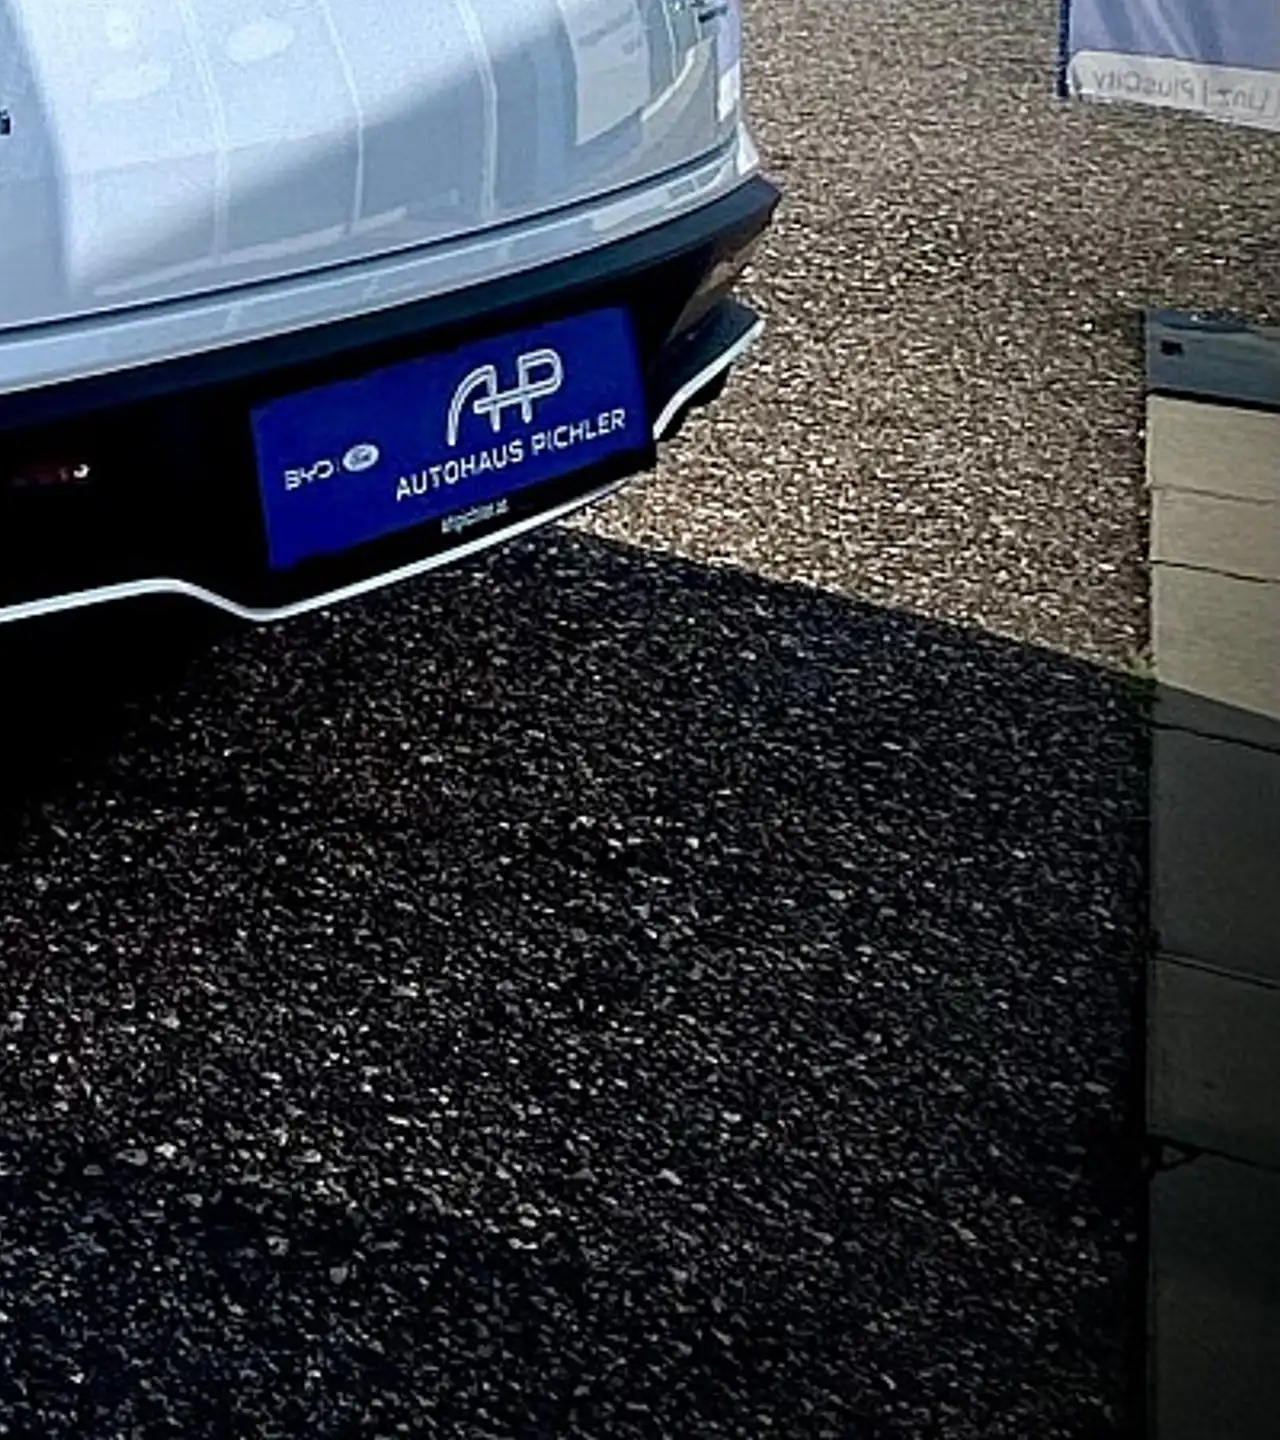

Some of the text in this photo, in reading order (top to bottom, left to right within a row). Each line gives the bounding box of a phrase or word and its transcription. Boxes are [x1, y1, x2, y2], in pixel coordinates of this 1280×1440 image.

[284, 459, 334, 491] BYD
[396, 407, 628, 503] AUTOHAUS PICHLER
